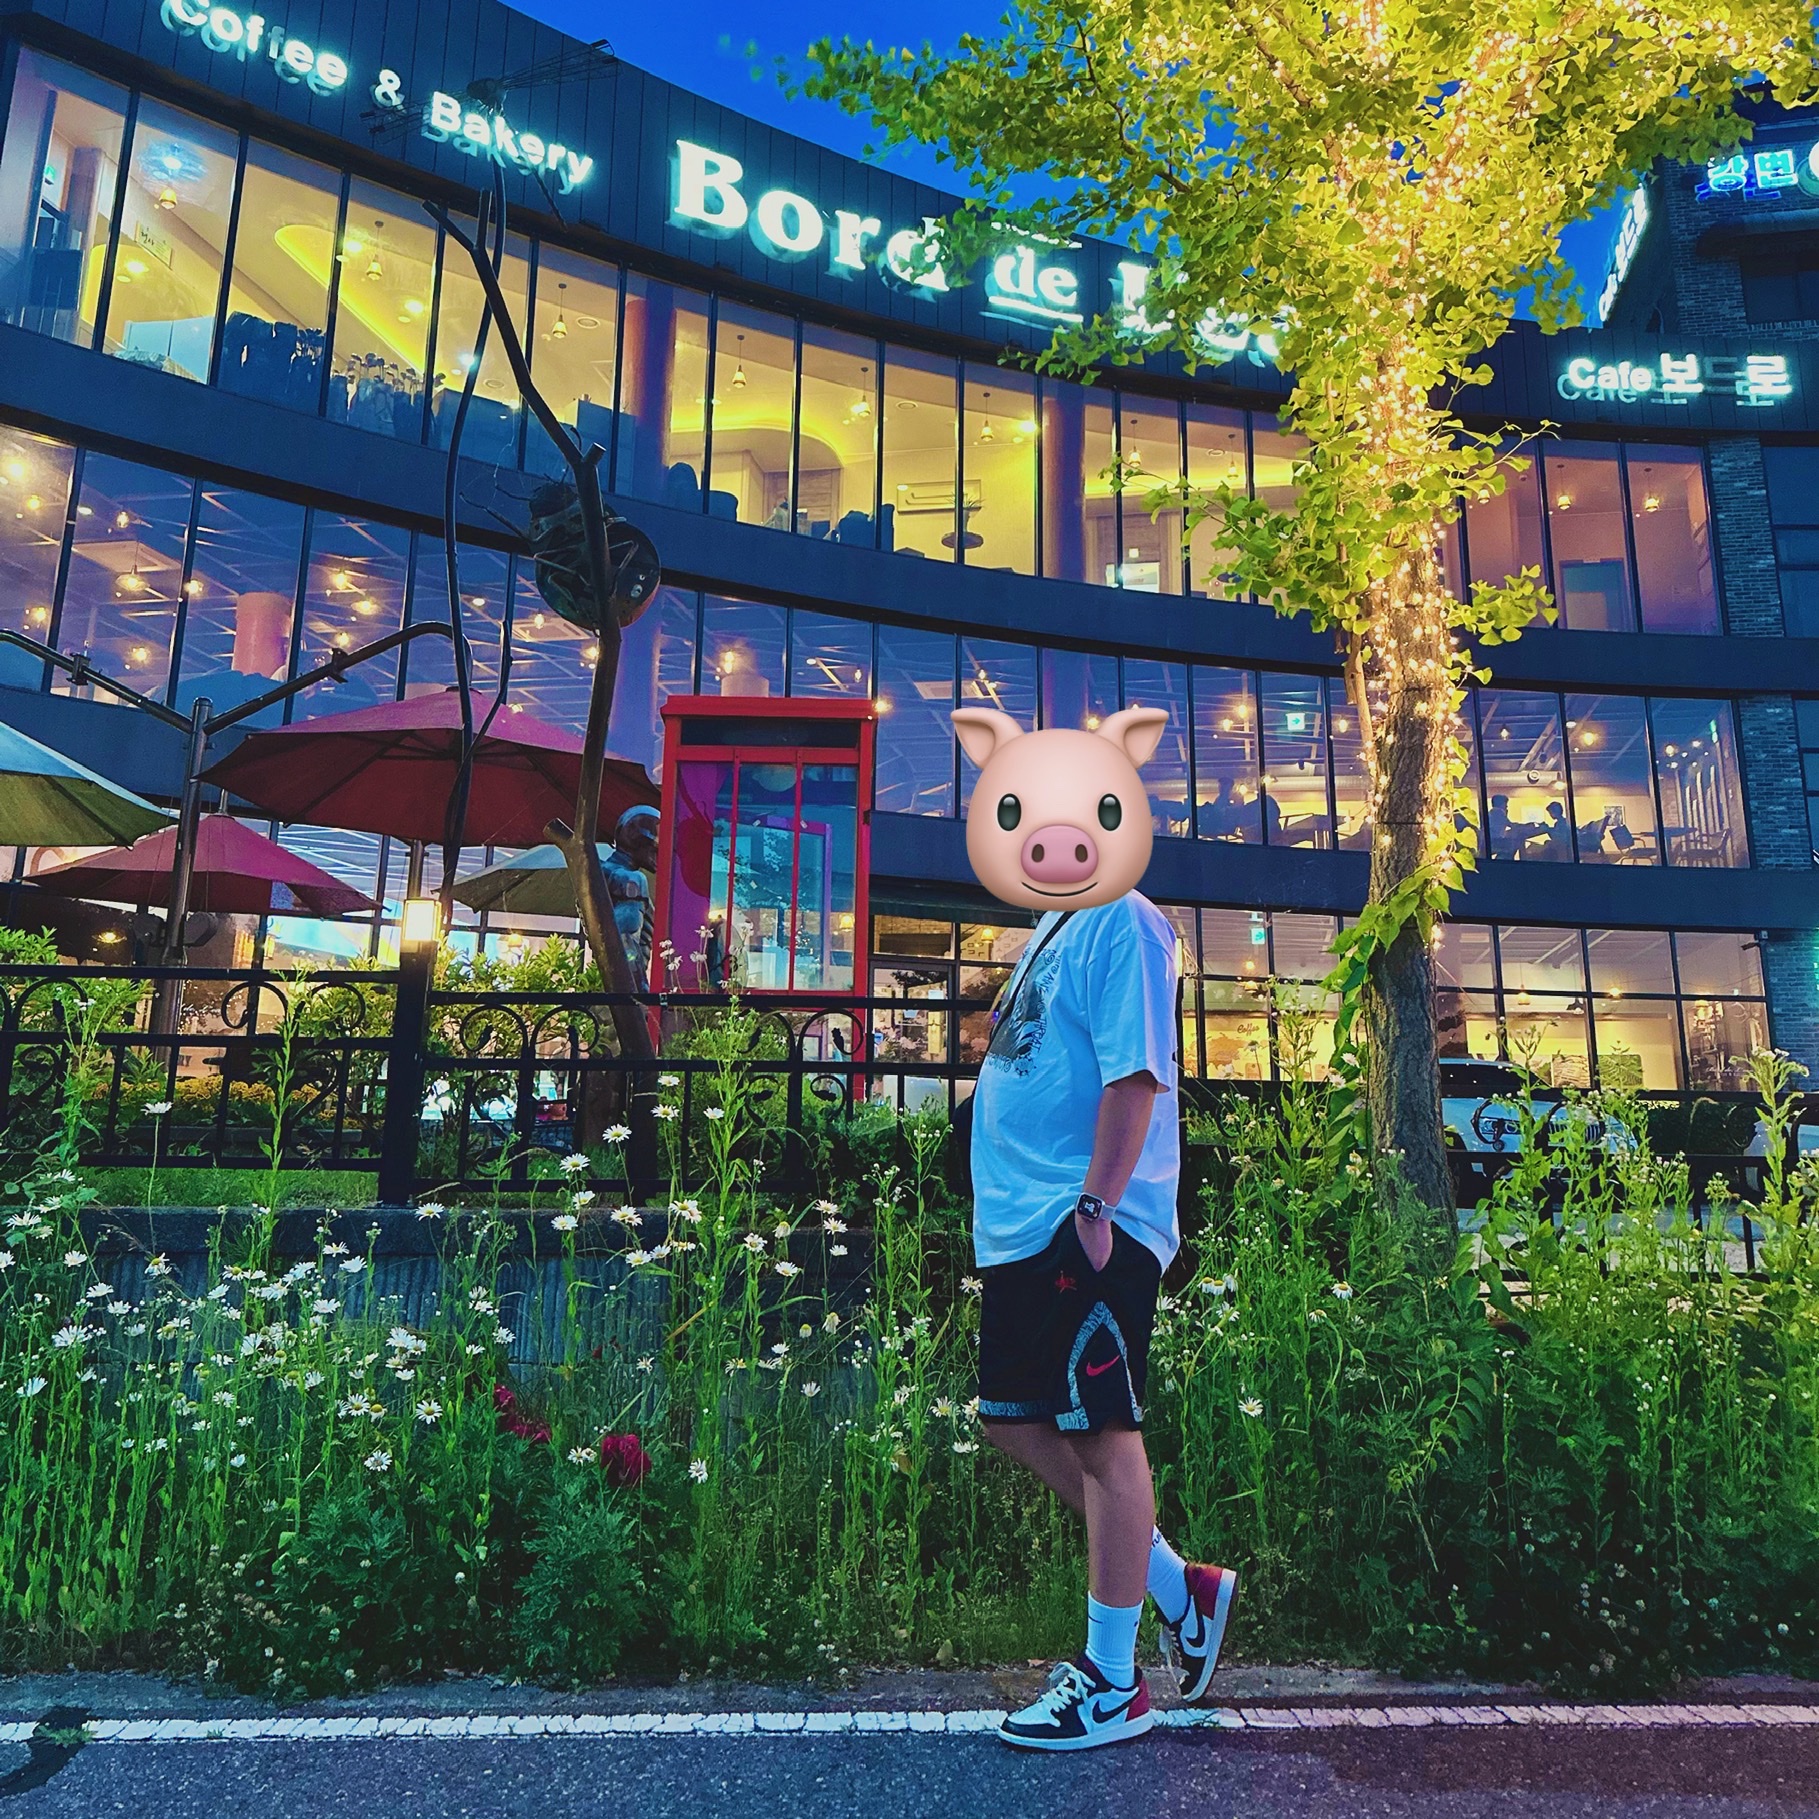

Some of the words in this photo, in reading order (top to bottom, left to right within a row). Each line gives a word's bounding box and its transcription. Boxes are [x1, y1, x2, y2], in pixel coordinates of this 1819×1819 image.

[165, 0, 348, 86] Coffee
[373, 68, 404, 109] &
[429, 91, 594, 185] Bakery
[993, 244, 1079, 307] de
[1567, 357, 1652, 393] Cafe
[1660, 353, 1793, 395] 보드로
